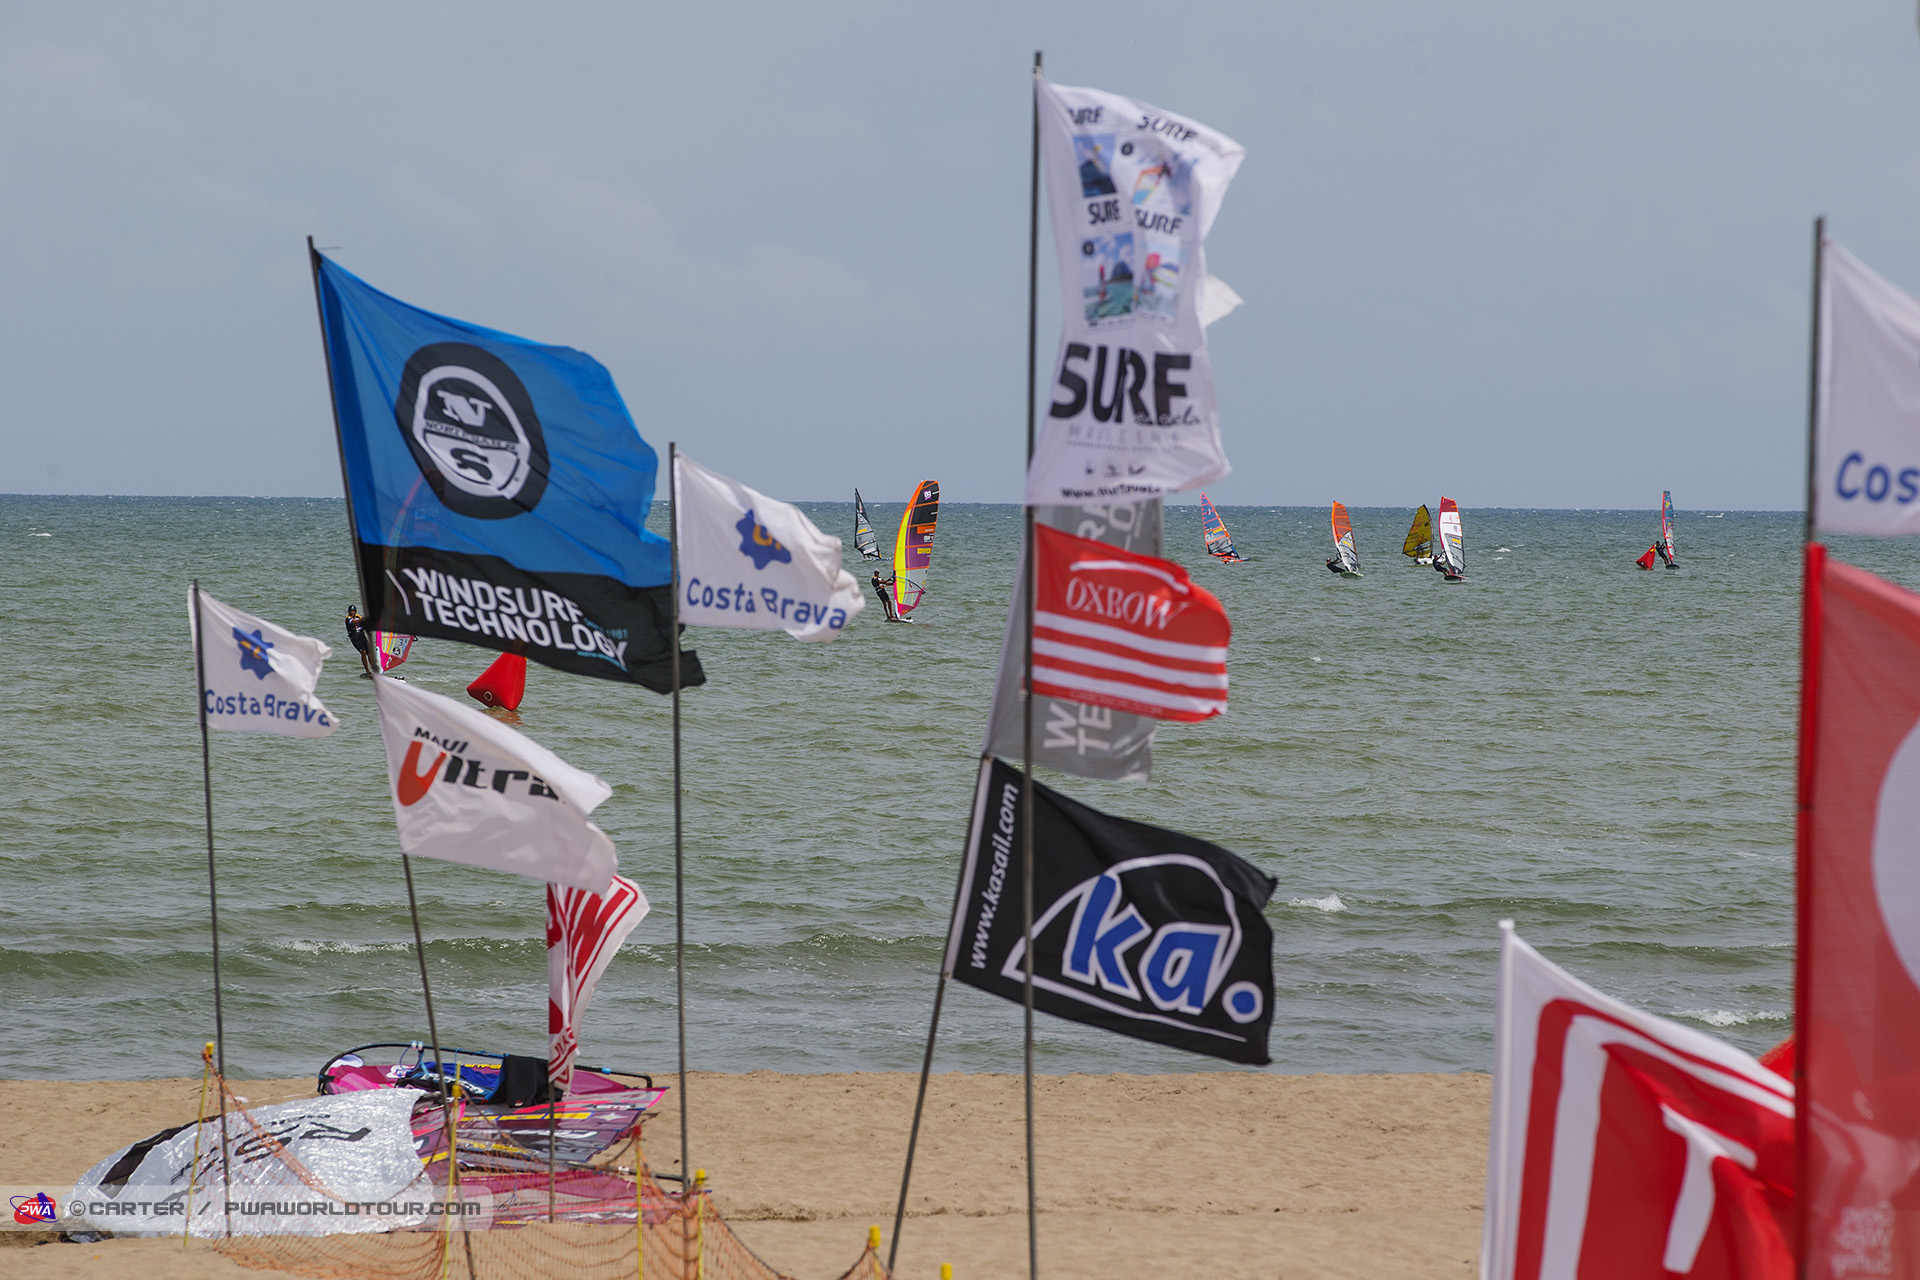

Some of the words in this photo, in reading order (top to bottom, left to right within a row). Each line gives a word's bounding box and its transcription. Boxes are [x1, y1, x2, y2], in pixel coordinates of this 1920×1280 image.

[1137, 115, 1198, 142] SURF
[1135, 208, 1183, 235] SURF
[1049, 343, 1192, 425] SURF
[401, 567, 585, 623] WINDSURF
[686, 577, 756, 613] Costa
[761, 587, 848, 630] Brava
[1066, 576, 1191, 631] OXBOW
[416, 593, 629, 669] TECHNOLOGY
[205, 688, 261, 715] Costa
[264, 694, 331, 728] Brava
[414, 725, 469, 754] MAUI
[397, 740, 559, 807] Ultra
[970, 783, 1020, 970] www.kasail.com
